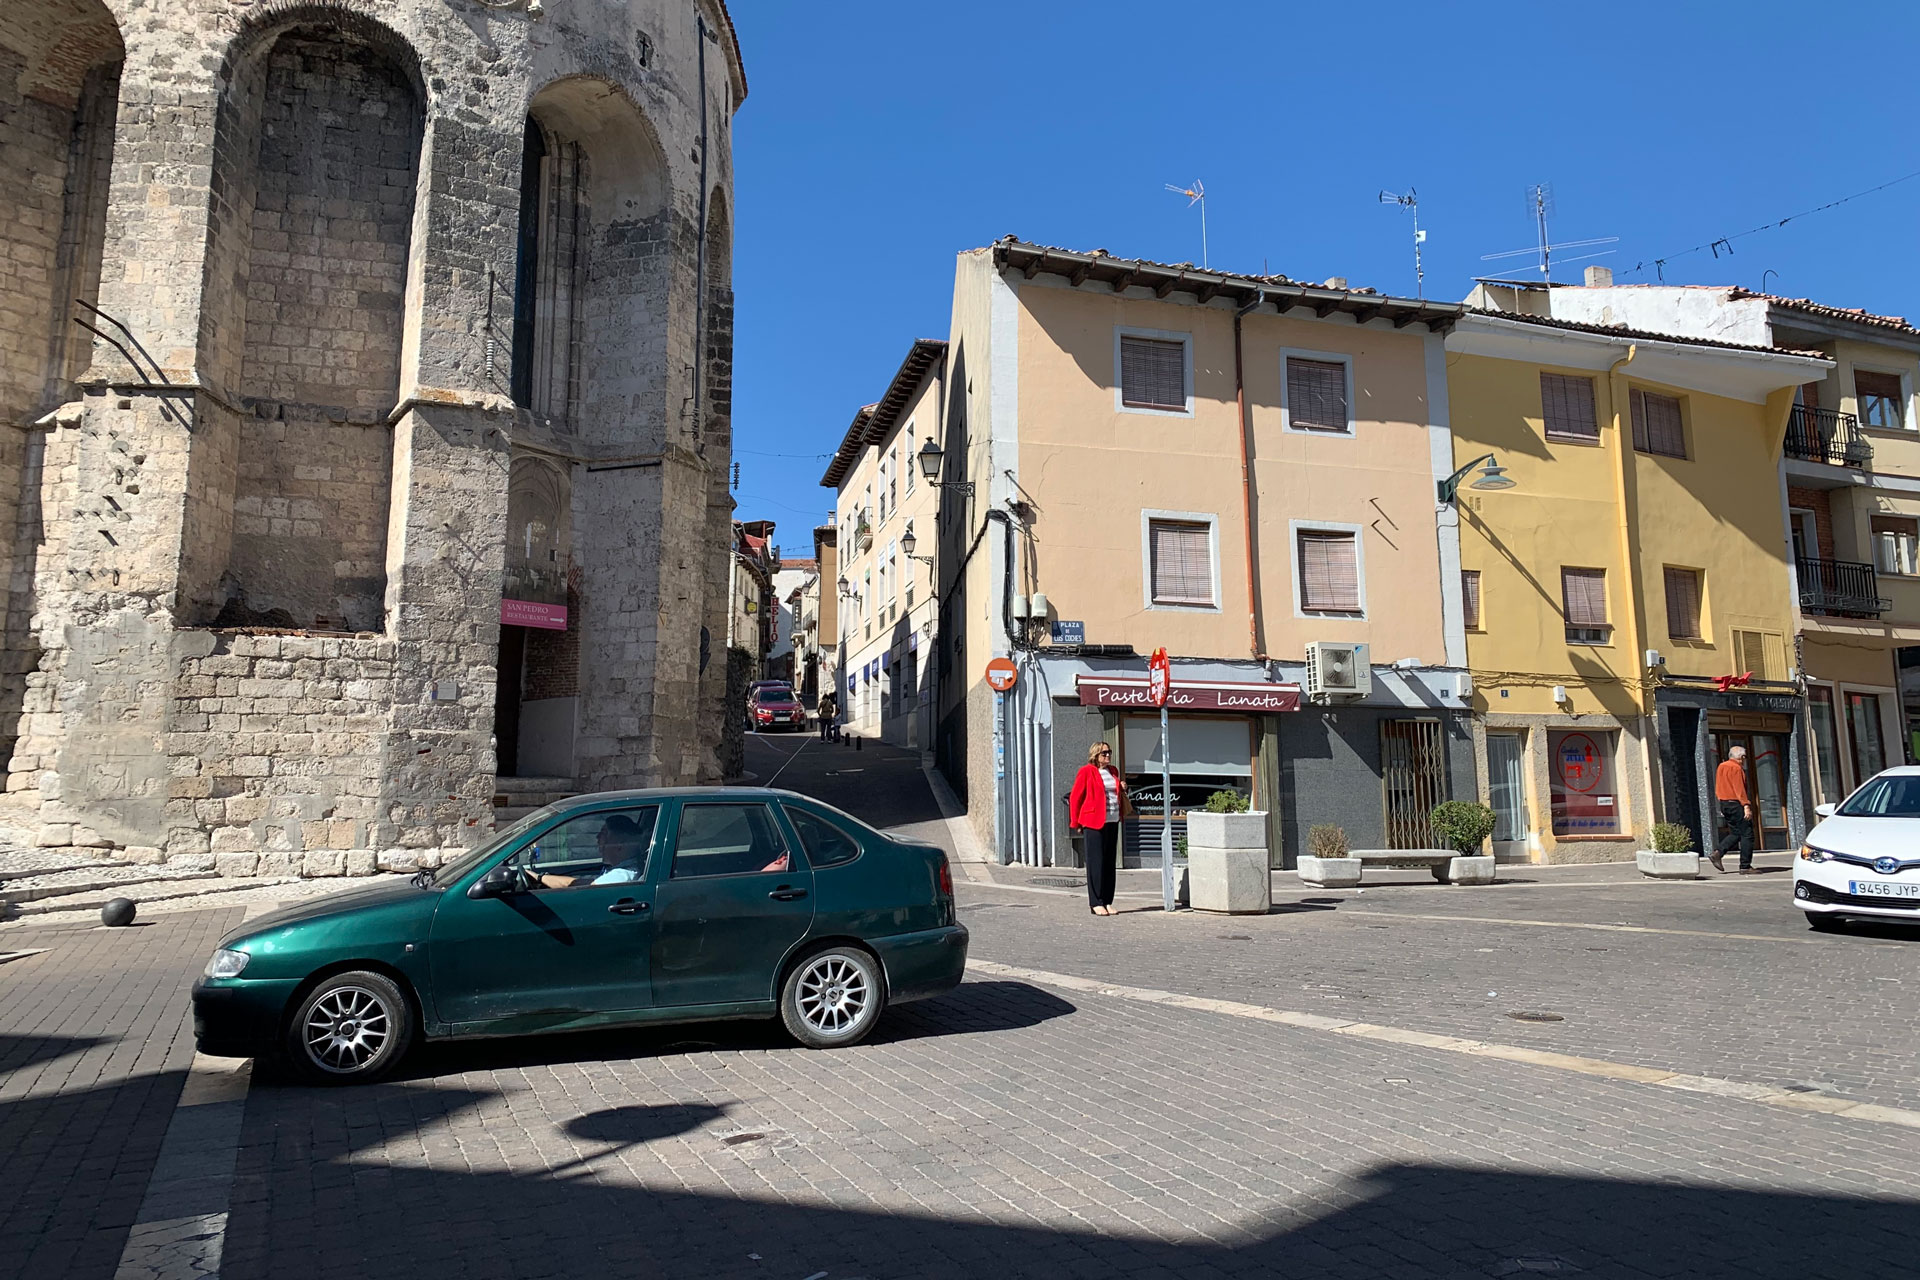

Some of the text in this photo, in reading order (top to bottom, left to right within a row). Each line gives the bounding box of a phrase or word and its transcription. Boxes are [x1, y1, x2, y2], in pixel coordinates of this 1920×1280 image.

[507, 603, 549, 614] SAN PEDRO
[506, 612, 548, 622] RESTAURANTE
[1097, 687, 1284, 706] Pastelría Lanata
[1128, 788, 1180, 802] Lanaa
[1858, 883, 1919, 896] 9456 JYP
